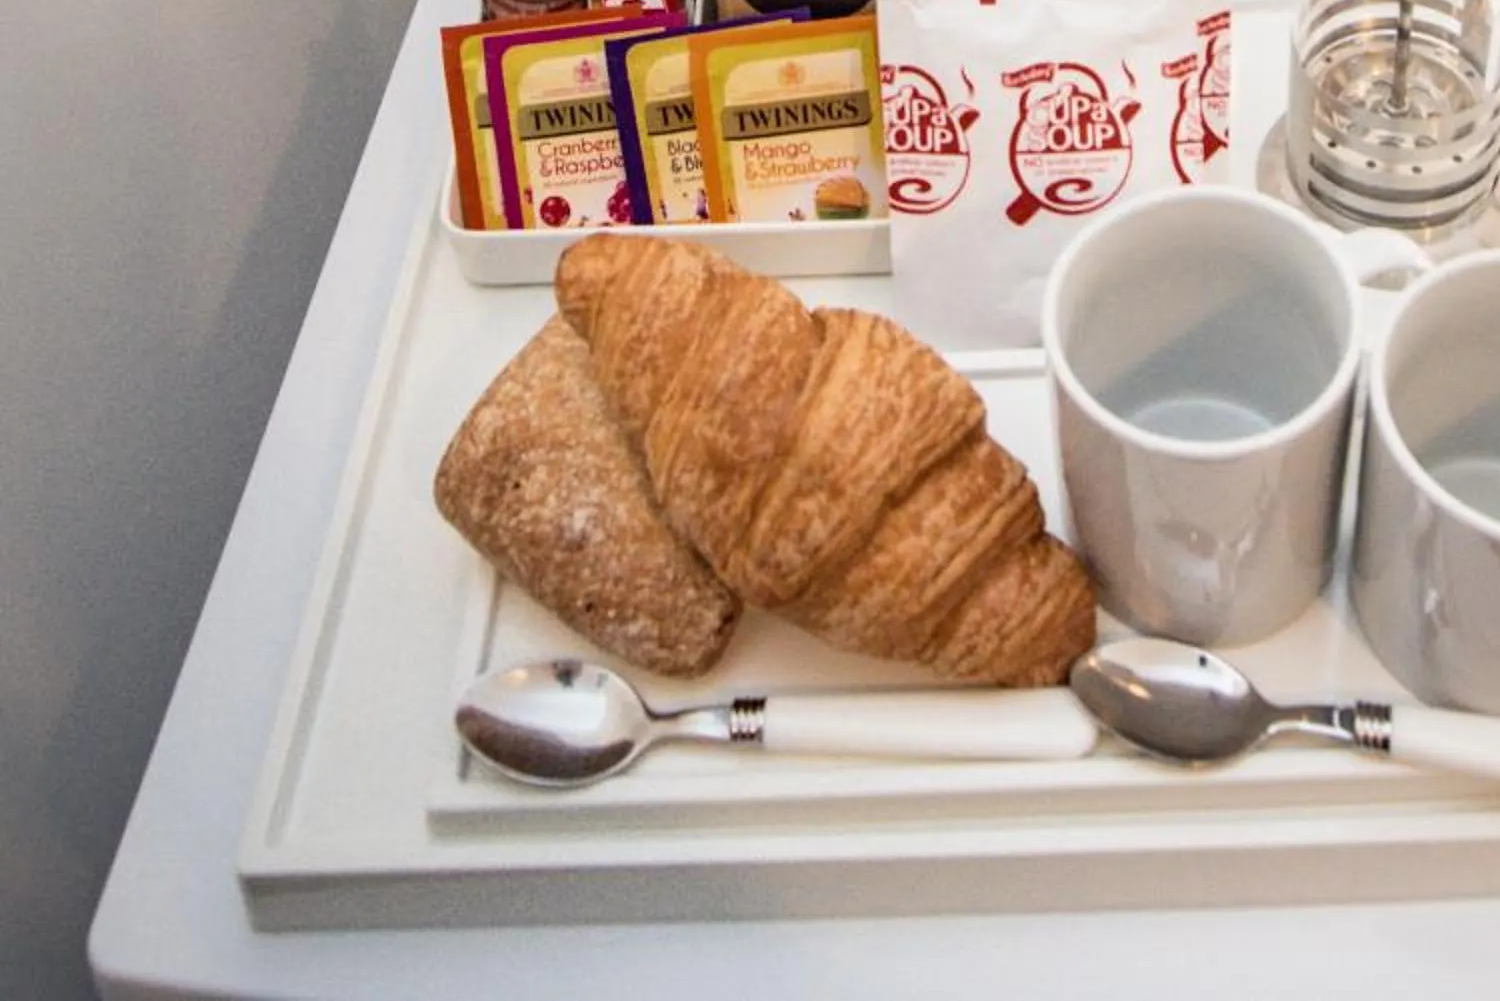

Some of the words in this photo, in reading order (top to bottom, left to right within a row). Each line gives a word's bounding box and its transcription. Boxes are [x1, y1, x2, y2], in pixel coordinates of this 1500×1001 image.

[734, 99, 860, 132] TWININGS
[538, 137, 617, 158] Cranberr
[743, 141, 812, 161] Mango
[885, 124, 954, 152] OUP
[1027, 122, 1115, 152] SOUP
